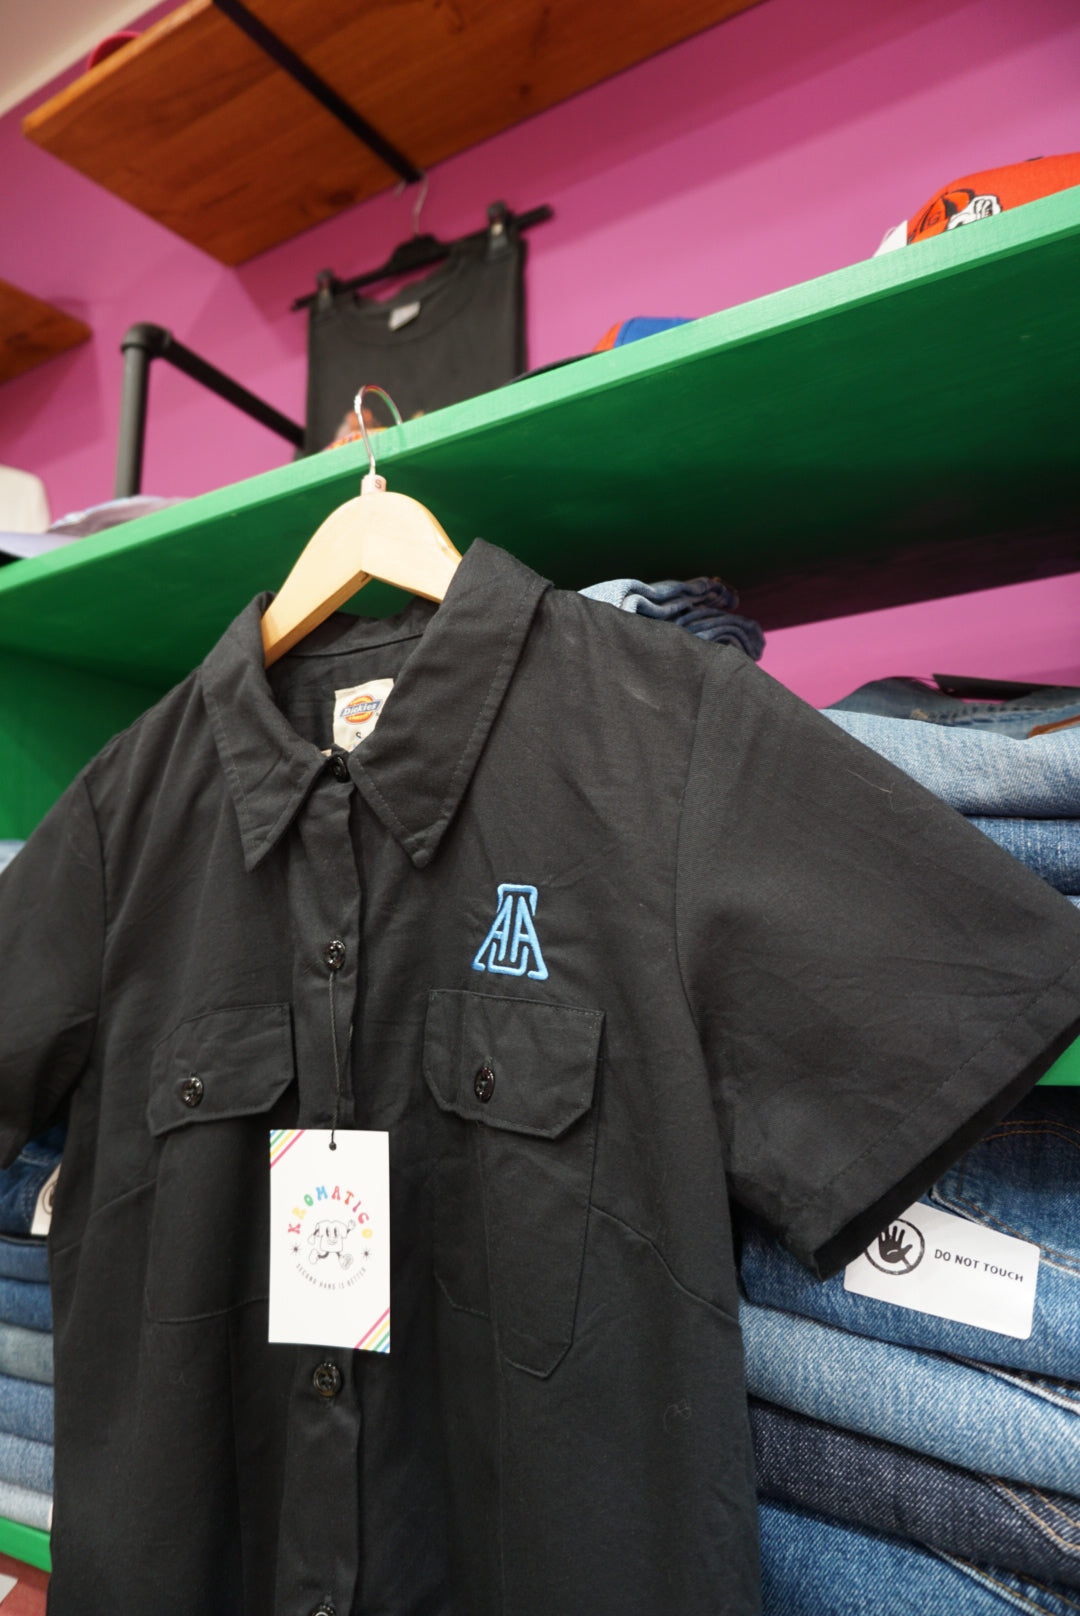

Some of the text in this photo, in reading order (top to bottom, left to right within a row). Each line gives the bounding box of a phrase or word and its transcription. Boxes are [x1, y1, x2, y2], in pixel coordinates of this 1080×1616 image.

[375, 479, 382, 489] S
[343, 703, 376, 716] Dickies
[287, 1185, 373, 1239] KROMATICO
[934, 1248, 1024, 1282] DO NOT TOUCH
